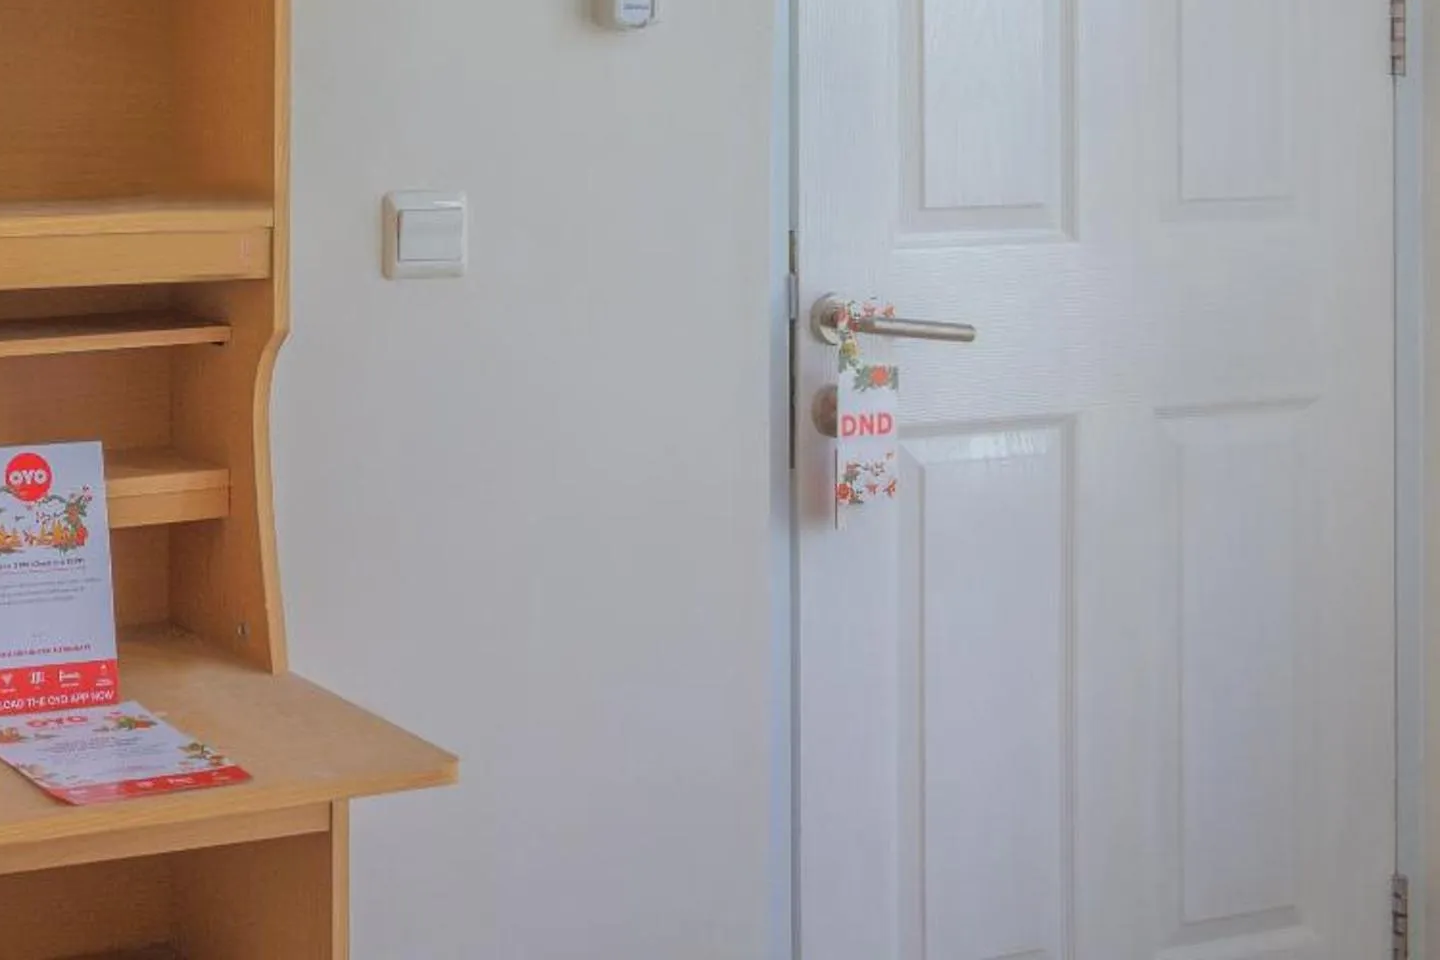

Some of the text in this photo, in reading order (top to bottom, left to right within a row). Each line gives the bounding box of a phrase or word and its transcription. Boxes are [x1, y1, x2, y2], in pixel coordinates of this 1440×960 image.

[840, 412, 893, 437] DND
[10, 469, 48, 485] OYO
[27, 697, 47, 707] THE
[71, 693, 90, 703] APP
[91, 690, 115, 702] NOW
